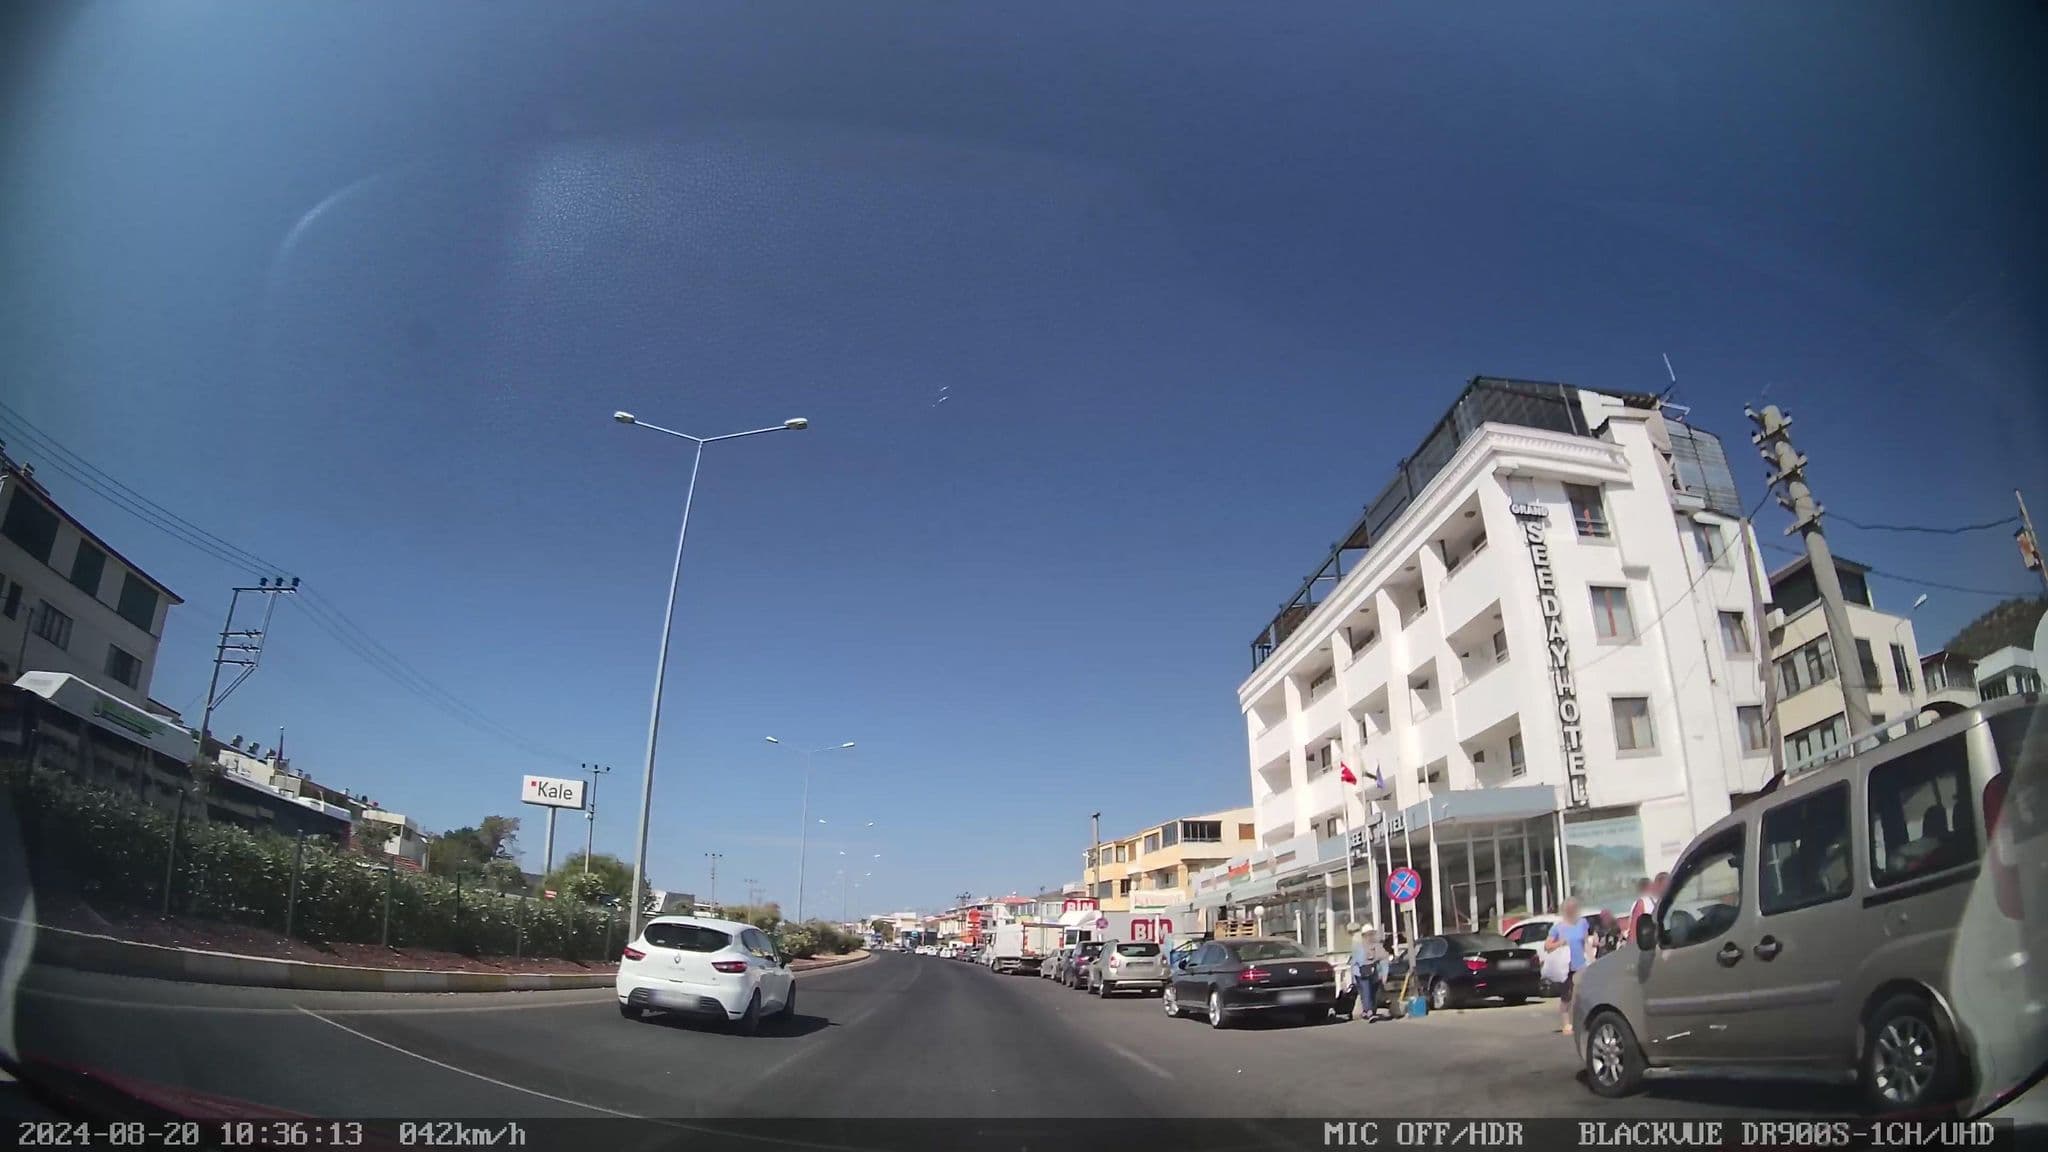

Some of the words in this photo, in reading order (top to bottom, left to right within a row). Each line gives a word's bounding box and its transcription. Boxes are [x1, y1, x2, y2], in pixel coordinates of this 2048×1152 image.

[1511, 503, 1549, 517] GRAND
[1525, 521, 1569, 667] SEEDAY
[1554, 670, 1589, 802] HOTEL
[538, 780, 573, 800] Kale
